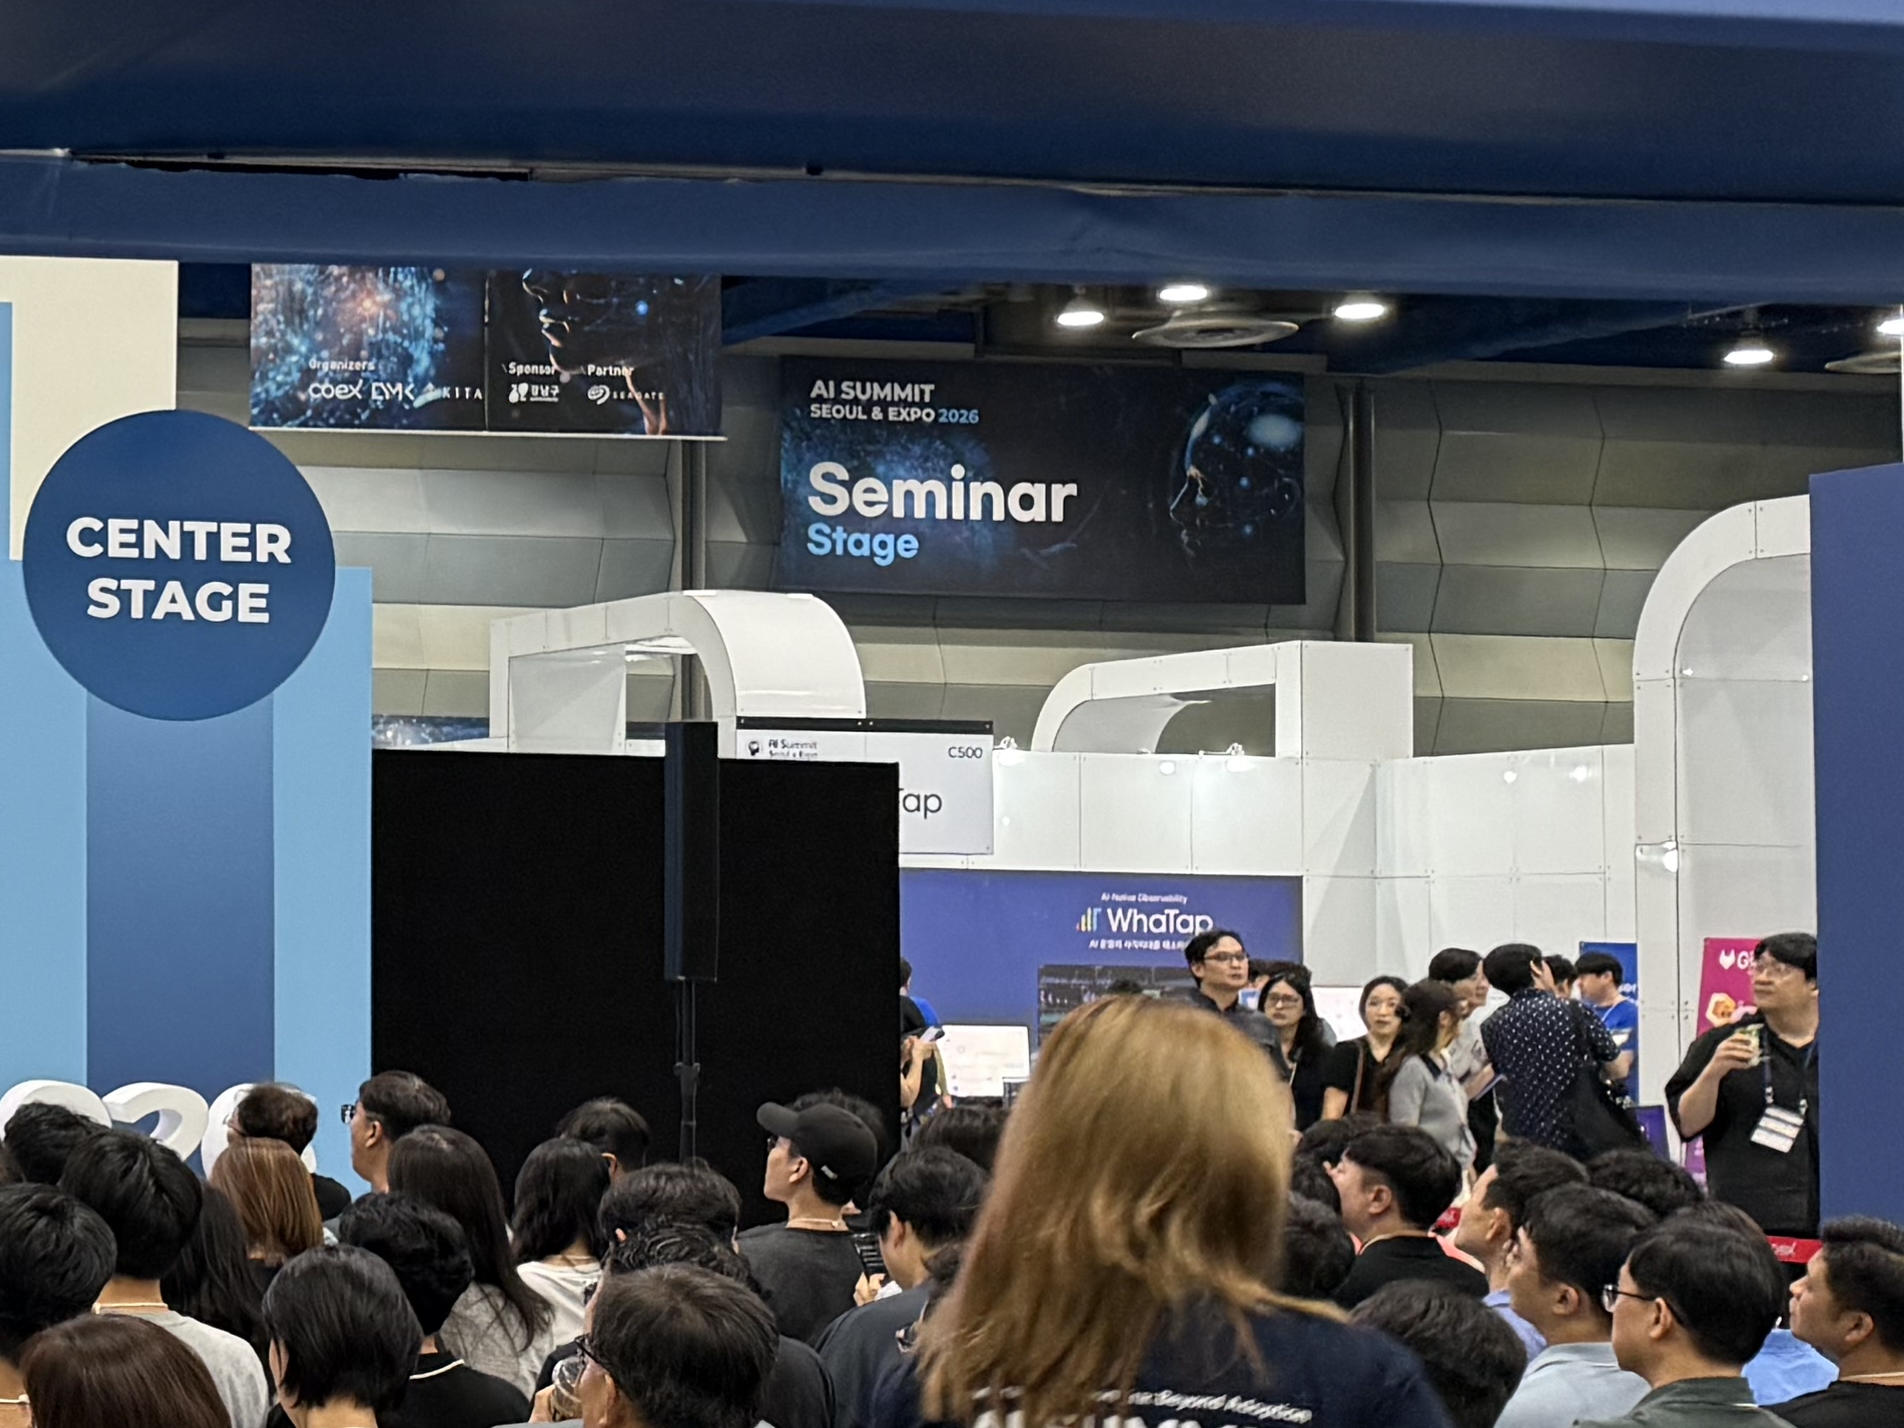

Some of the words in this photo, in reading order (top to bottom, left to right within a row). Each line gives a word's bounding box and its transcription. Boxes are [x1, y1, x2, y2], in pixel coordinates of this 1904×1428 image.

[308, 359, 376, 372] Organizers
[508, 361, 556, 376] Sponsor
[587, 364, 635, 376] Partner
[308, 379, 364, 400] coex
[442, 386, 484, 400] KITA
[810, 380, 835, 400] AI
[840, 381, 935, 403] SUMMIT
[810, 403, 867, 421] SEOUL
[871, 406, 884, 421] &
[888, 405, 935, 423] EXPO
[938, 408, 980, 424] 2026
[807, 460, 1078, 523] Seminar
[65, 516, 292, 564] CENTER
[806, 522, 920, 567] Stage
[86, 577, 271, 624] STAGE
[948, 746, 983, 760] C500
[1106, 907, 1213, 936] WhaTap
